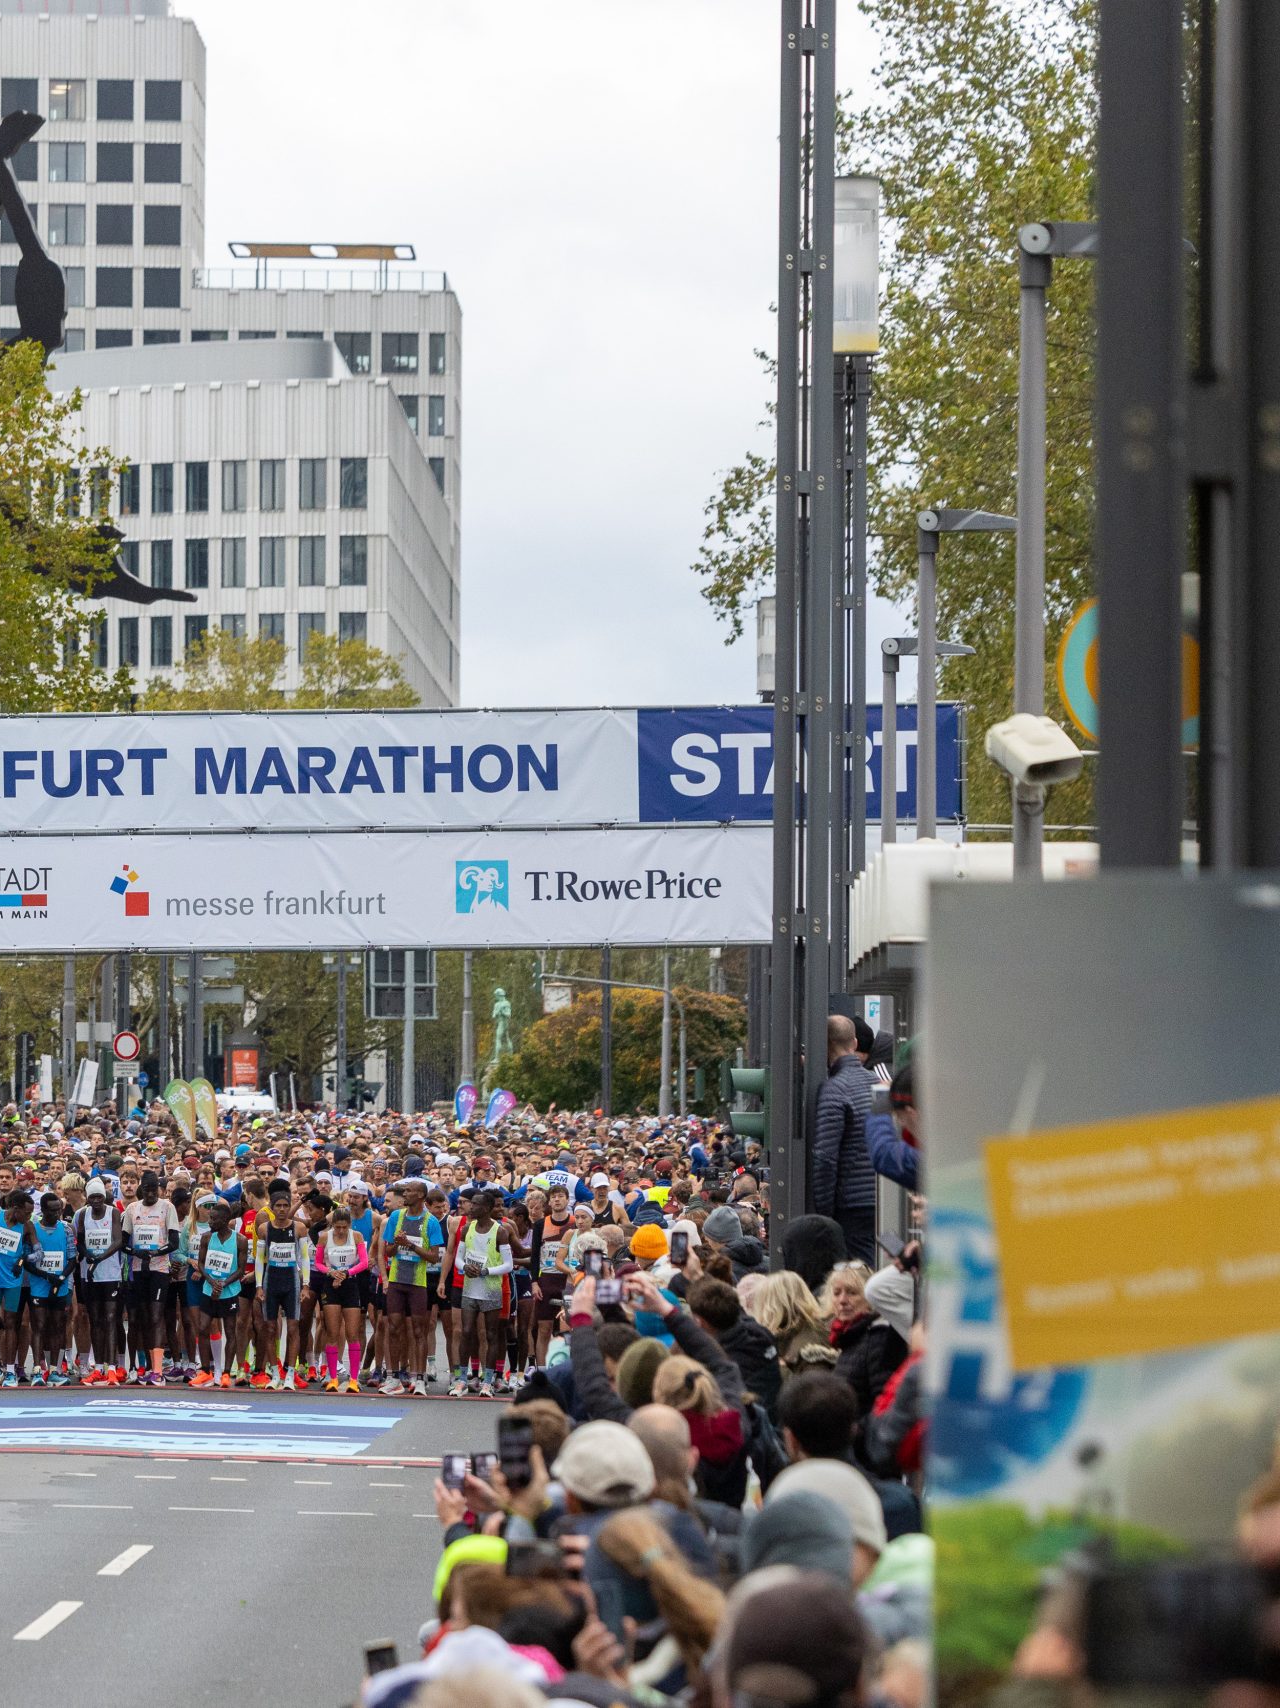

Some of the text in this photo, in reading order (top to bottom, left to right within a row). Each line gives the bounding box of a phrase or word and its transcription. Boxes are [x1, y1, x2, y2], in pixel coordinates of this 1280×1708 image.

[670, 730, 918, 797] STT
[194, 743, 559, 795] MARATHON
[166, 889, 386, 916] messe frankfurt
[11, 910, 49, 919] MAIN
[545, 1173, 569, 1184] TEAM
[8, 1240, 16, 1248] M
[88, 1238, 108, 1246] PACE M
[40, 1260, 60, 1268] PACE M
[208, 1259, 222, 1268] PACE
